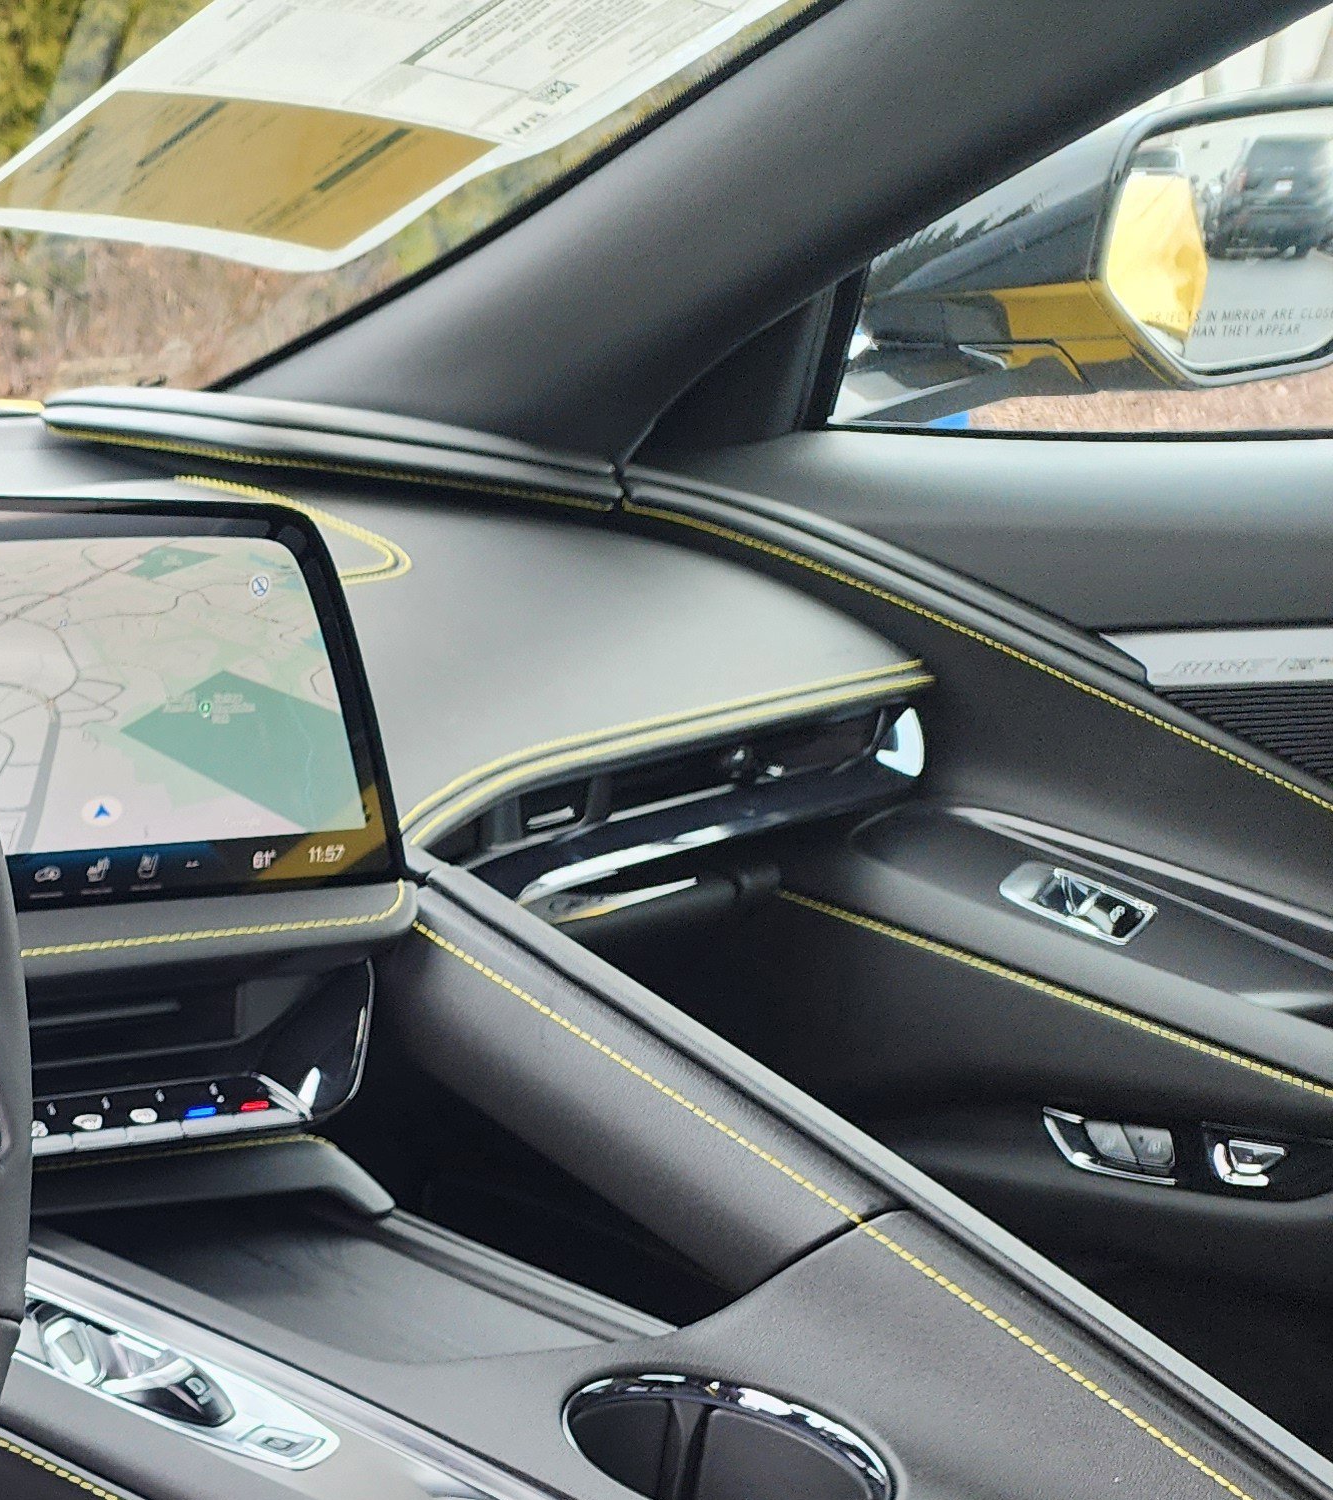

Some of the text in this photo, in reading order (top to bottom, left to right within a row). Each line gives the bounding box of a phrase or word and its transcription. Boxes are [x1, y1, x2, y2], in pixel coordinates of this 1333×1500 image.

[1221, 309, 1266, 321] MIRROR
[1271, 308, 1294, 320] ARE
[1222, 324, 1251, 337] THEY
[1256, 323, 1301, 337] APPEAR
[307, 844, 346, 864] 11:57
